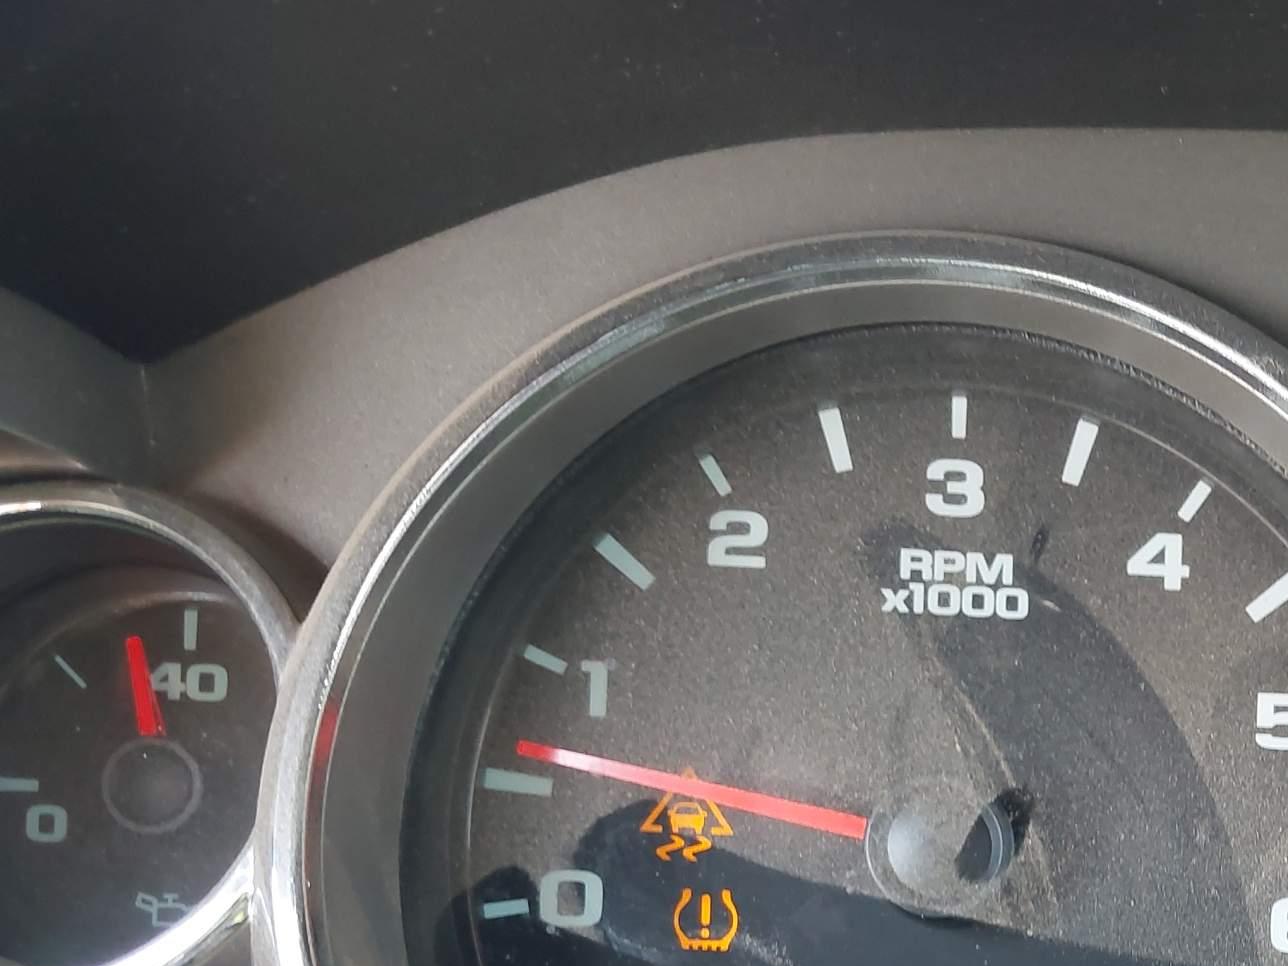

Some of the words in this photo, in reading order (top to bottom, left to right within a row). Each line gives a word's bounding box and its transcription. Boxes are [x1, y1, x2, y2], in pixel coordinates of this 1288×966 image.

[925, 459, 986, 517] 3
[707, 510, 769, 568] 2
[900, 548, 1014, 585] RPM
[1127, 533, 1190, 590] 4
[881, 582, 1029, 620] x1000
[150, 662, 228, 702] 40
[580, 660, 611, 719] 1
[26, 805, 68, 843] 0
[540, 869, 604, 927] 0
